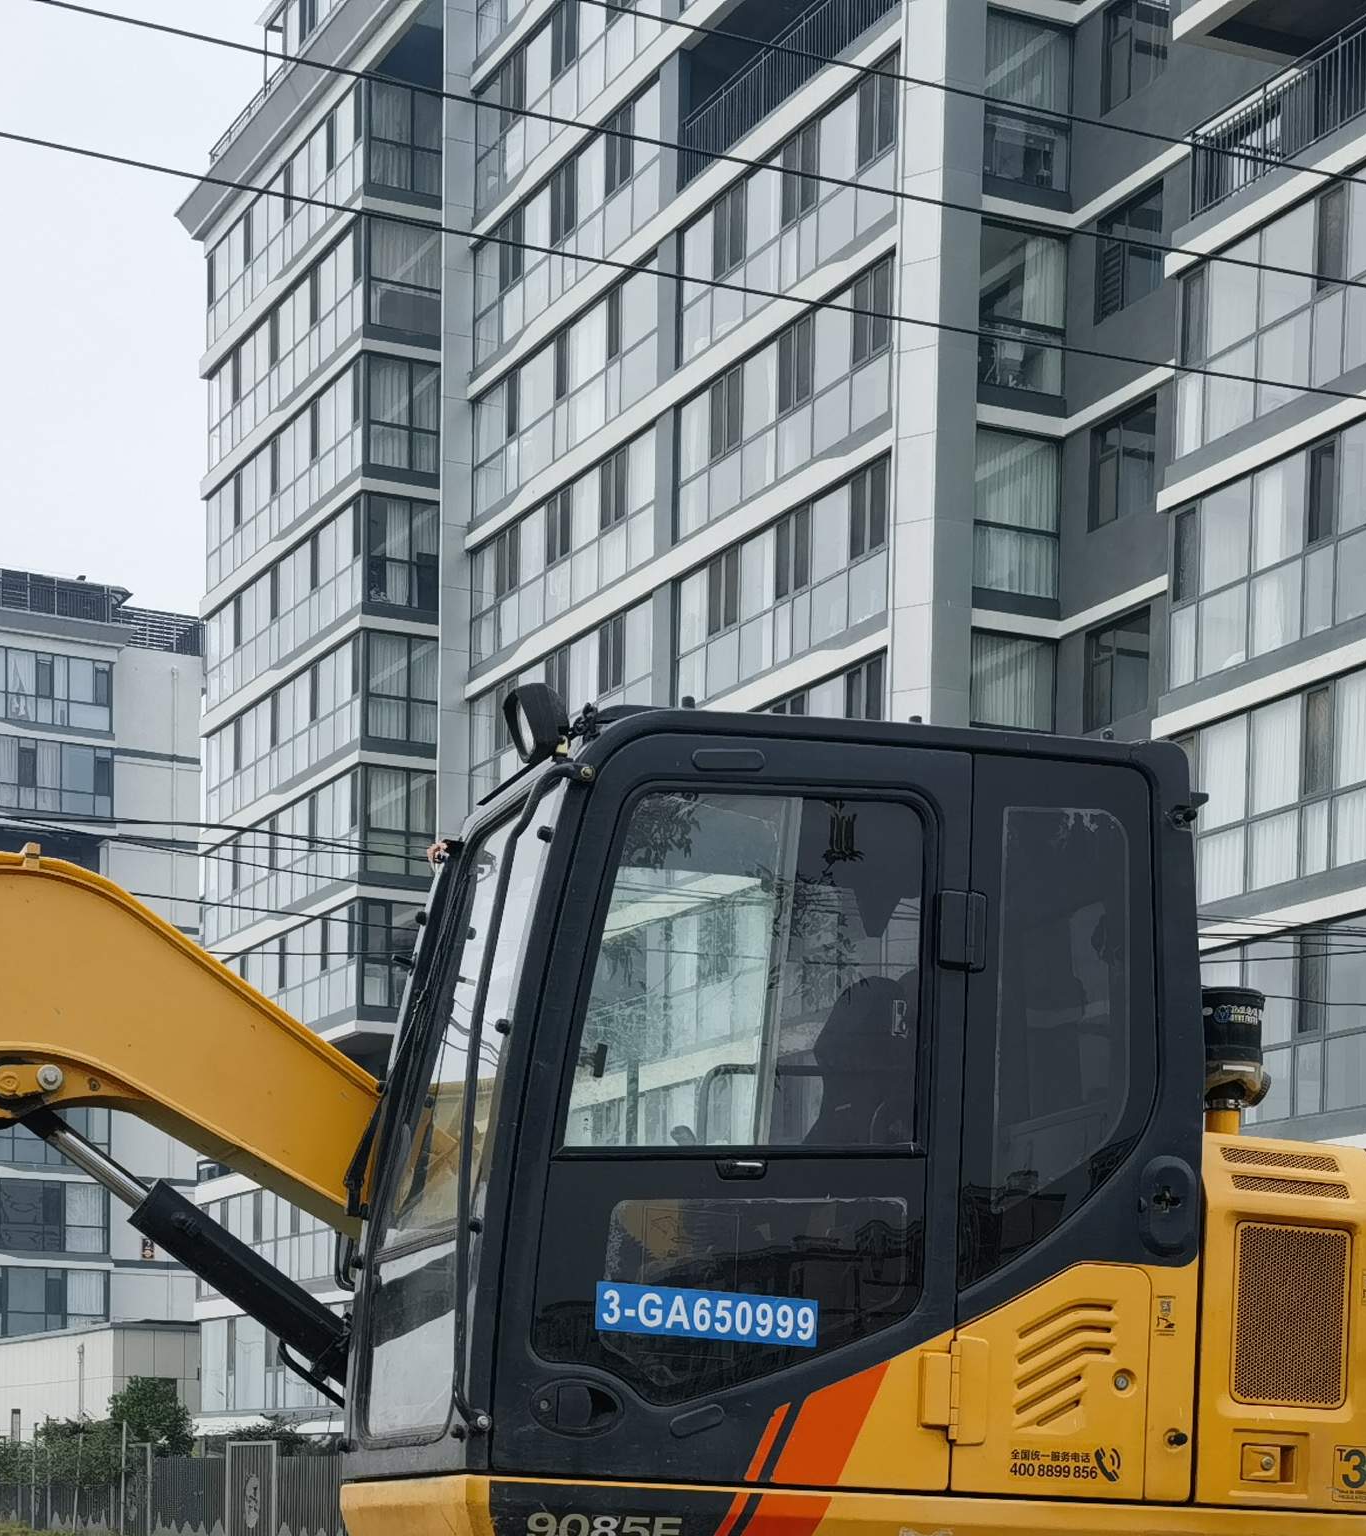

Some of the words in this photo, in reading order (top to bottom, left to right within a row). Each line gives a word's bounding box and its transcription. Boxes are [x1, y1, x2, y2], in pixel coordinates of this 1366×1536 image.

[602, 1289, 815, 1341] 3-GA650999
[1010, 1449, 1091, 1463] 全国统一服务电话
[1010, 1463, 1035, 1477] 400
[1037, 1464, 1070, 1478] 8899
[1073, 1466, 1098, 1479] 856
